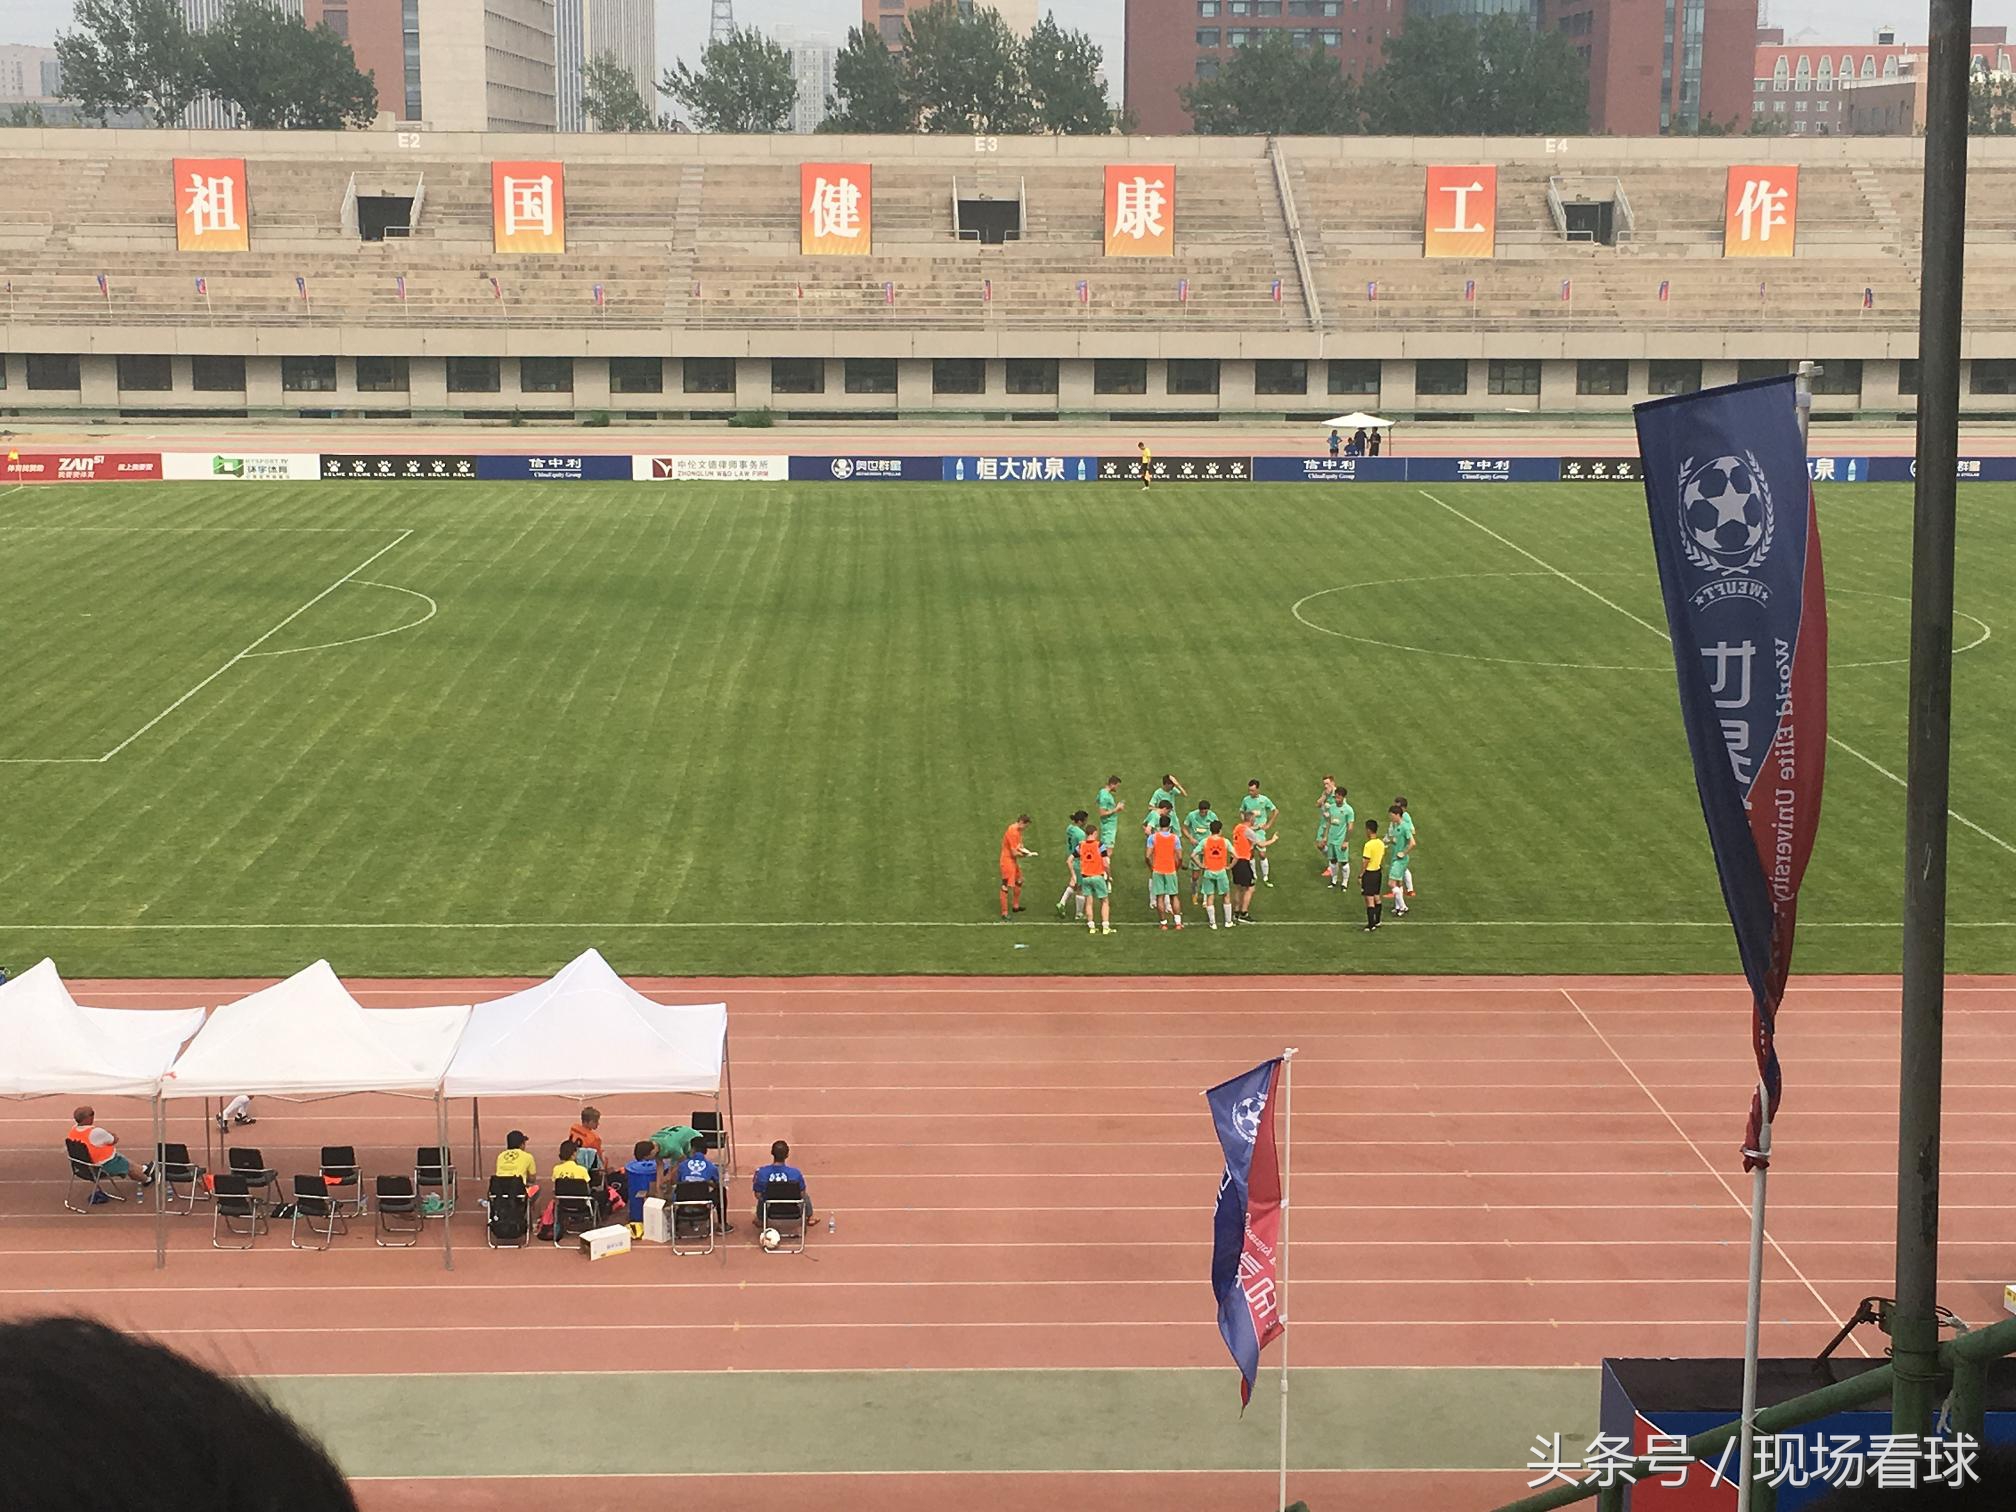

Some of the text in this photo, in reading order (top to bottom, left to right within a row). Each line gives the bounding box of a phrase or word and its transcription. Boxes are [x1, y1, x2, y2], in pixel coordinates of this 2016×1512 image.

[397, 132, 421, 148] E2
[974, 136, 998, 152] E3
[1545, 138, 1569, 153] E4
[185, 173, 240, 235] 祖
[504, 175, 553, 236] 国
[809, 176, 861, 238] 健
[1113, 176, 1166, 239] 康
[1433, 181, 1485, 233] 工
[1734, 180, 1788, 242] 作
[528, 458, 582, 469] 信中利
[677, 460, 769, 470] 中伦文德律师事务所
[976, 457, 1065, 481] 恒大冰泉
[1303, 459, 1356, 470] 信中利
[1457, 460, 1510, 470] 信中利
